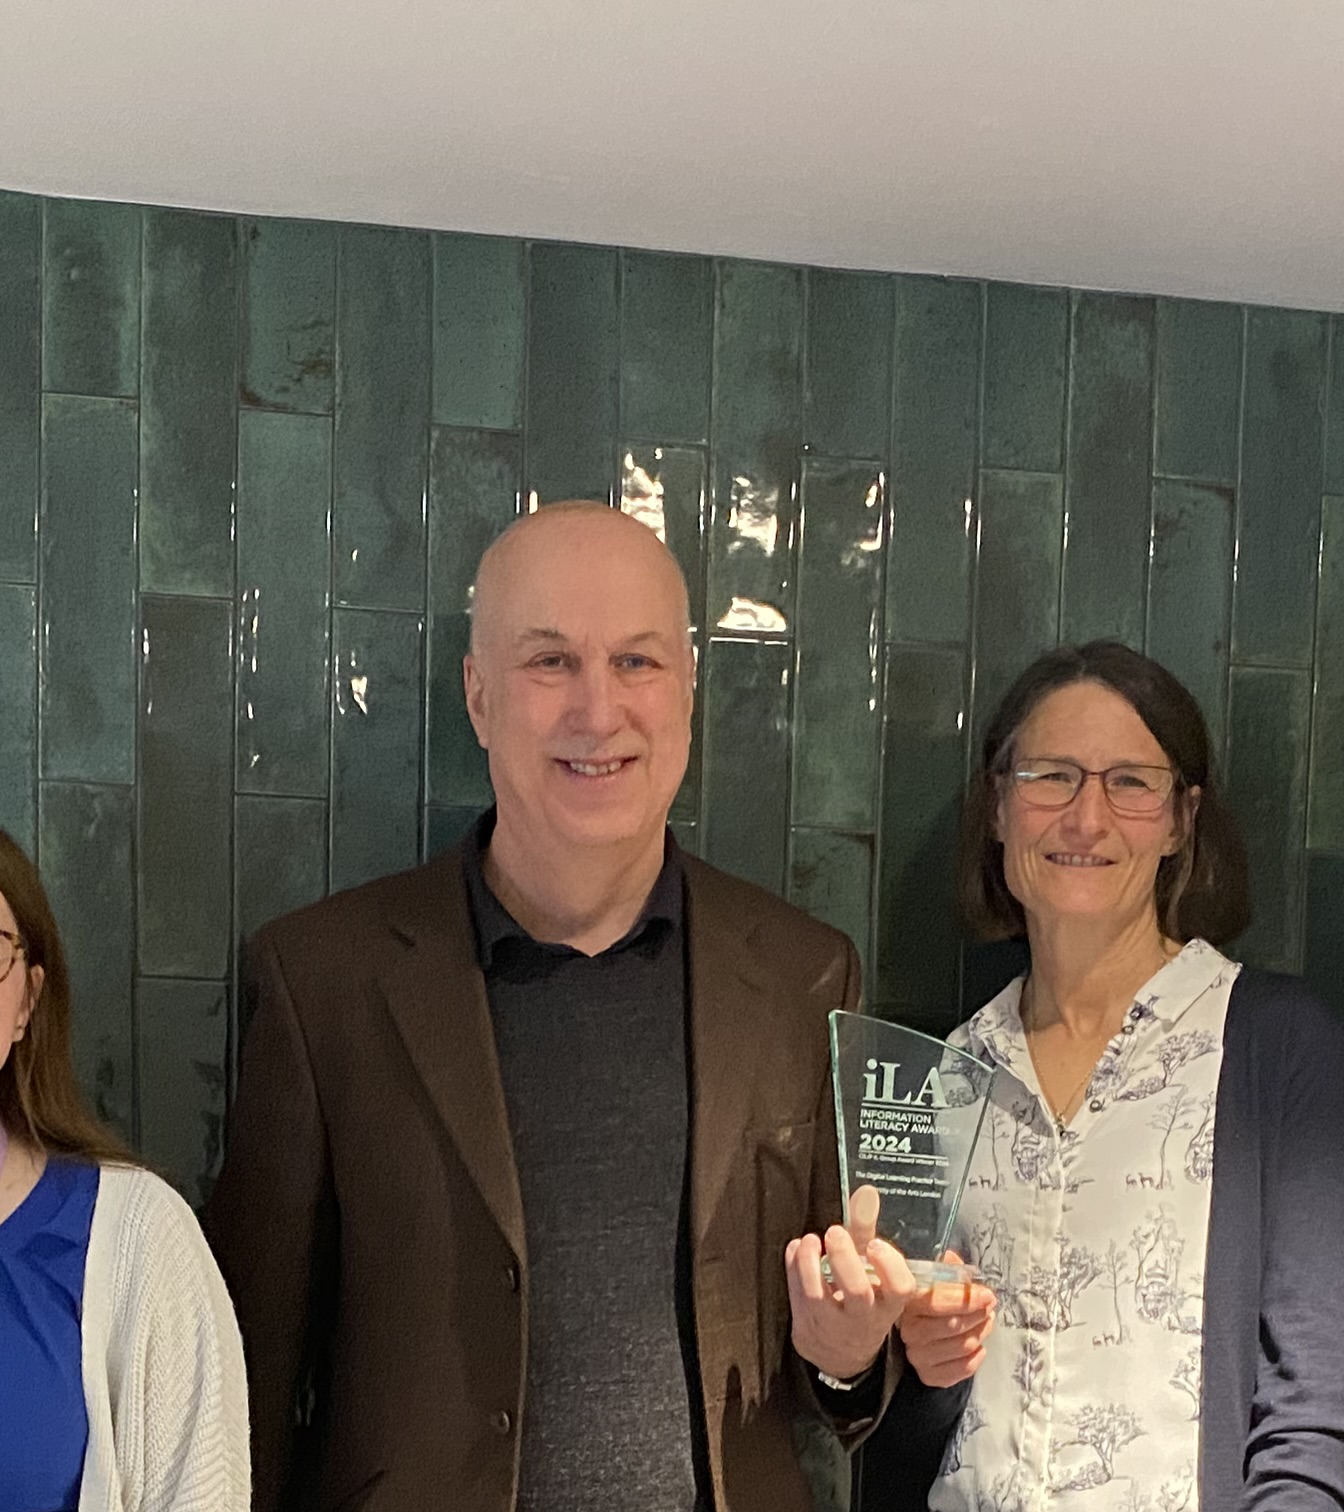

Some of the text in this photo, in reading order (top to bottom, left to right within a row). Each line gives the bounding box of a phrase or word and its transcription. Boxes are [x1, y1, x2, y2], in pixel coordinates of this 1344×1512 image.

[862, 1058, 952, 1108] iLA
[860, 1109, 931, 1124] INFORMATION
[859, 1119, 950, 1135] LITERACY AWARD
[858, 1133, 912, 1153] 2024
